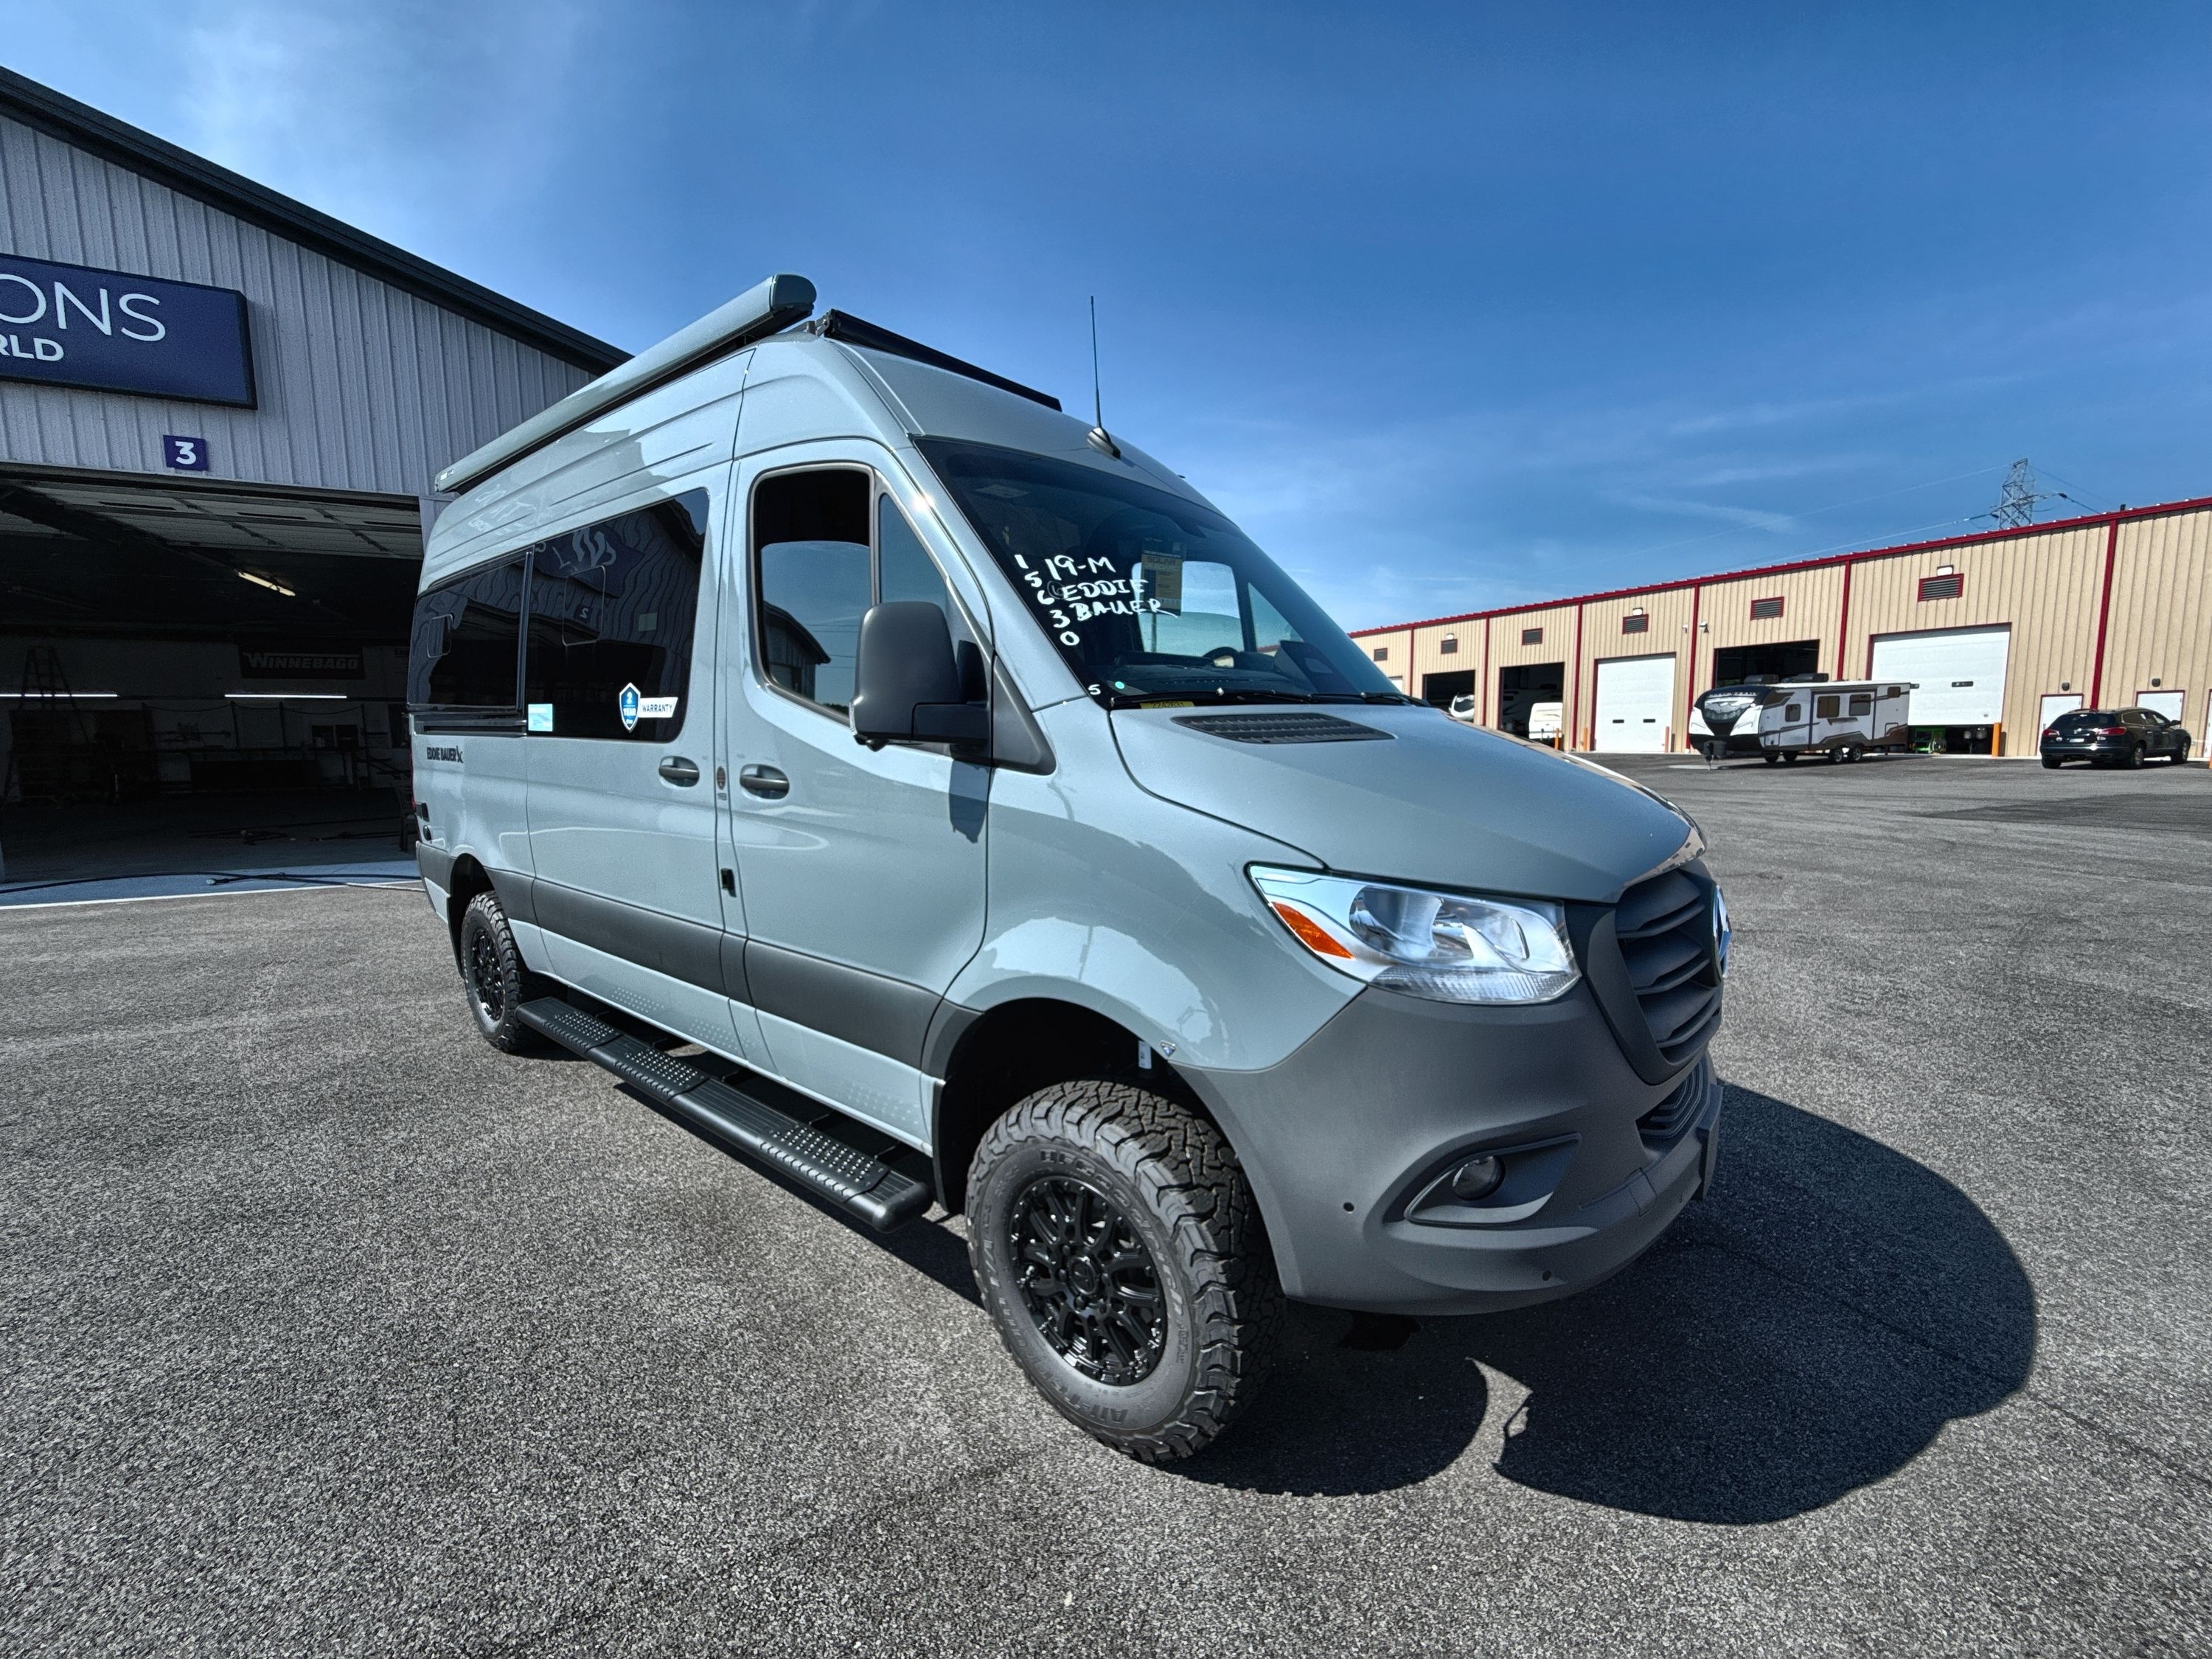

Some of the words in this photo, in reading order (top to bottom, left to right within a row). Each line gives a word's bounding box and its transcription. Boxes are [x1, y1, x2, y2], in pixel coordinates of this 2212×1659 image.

[175, 440, 197, 465] 3
[1044, 554, 1116, 581] 19-M
[1062, 578, 1149, 602] EDDIE
[1068, 598, 1178, 622] BAUER
[642, 703, 673, 713] WARRANTY
